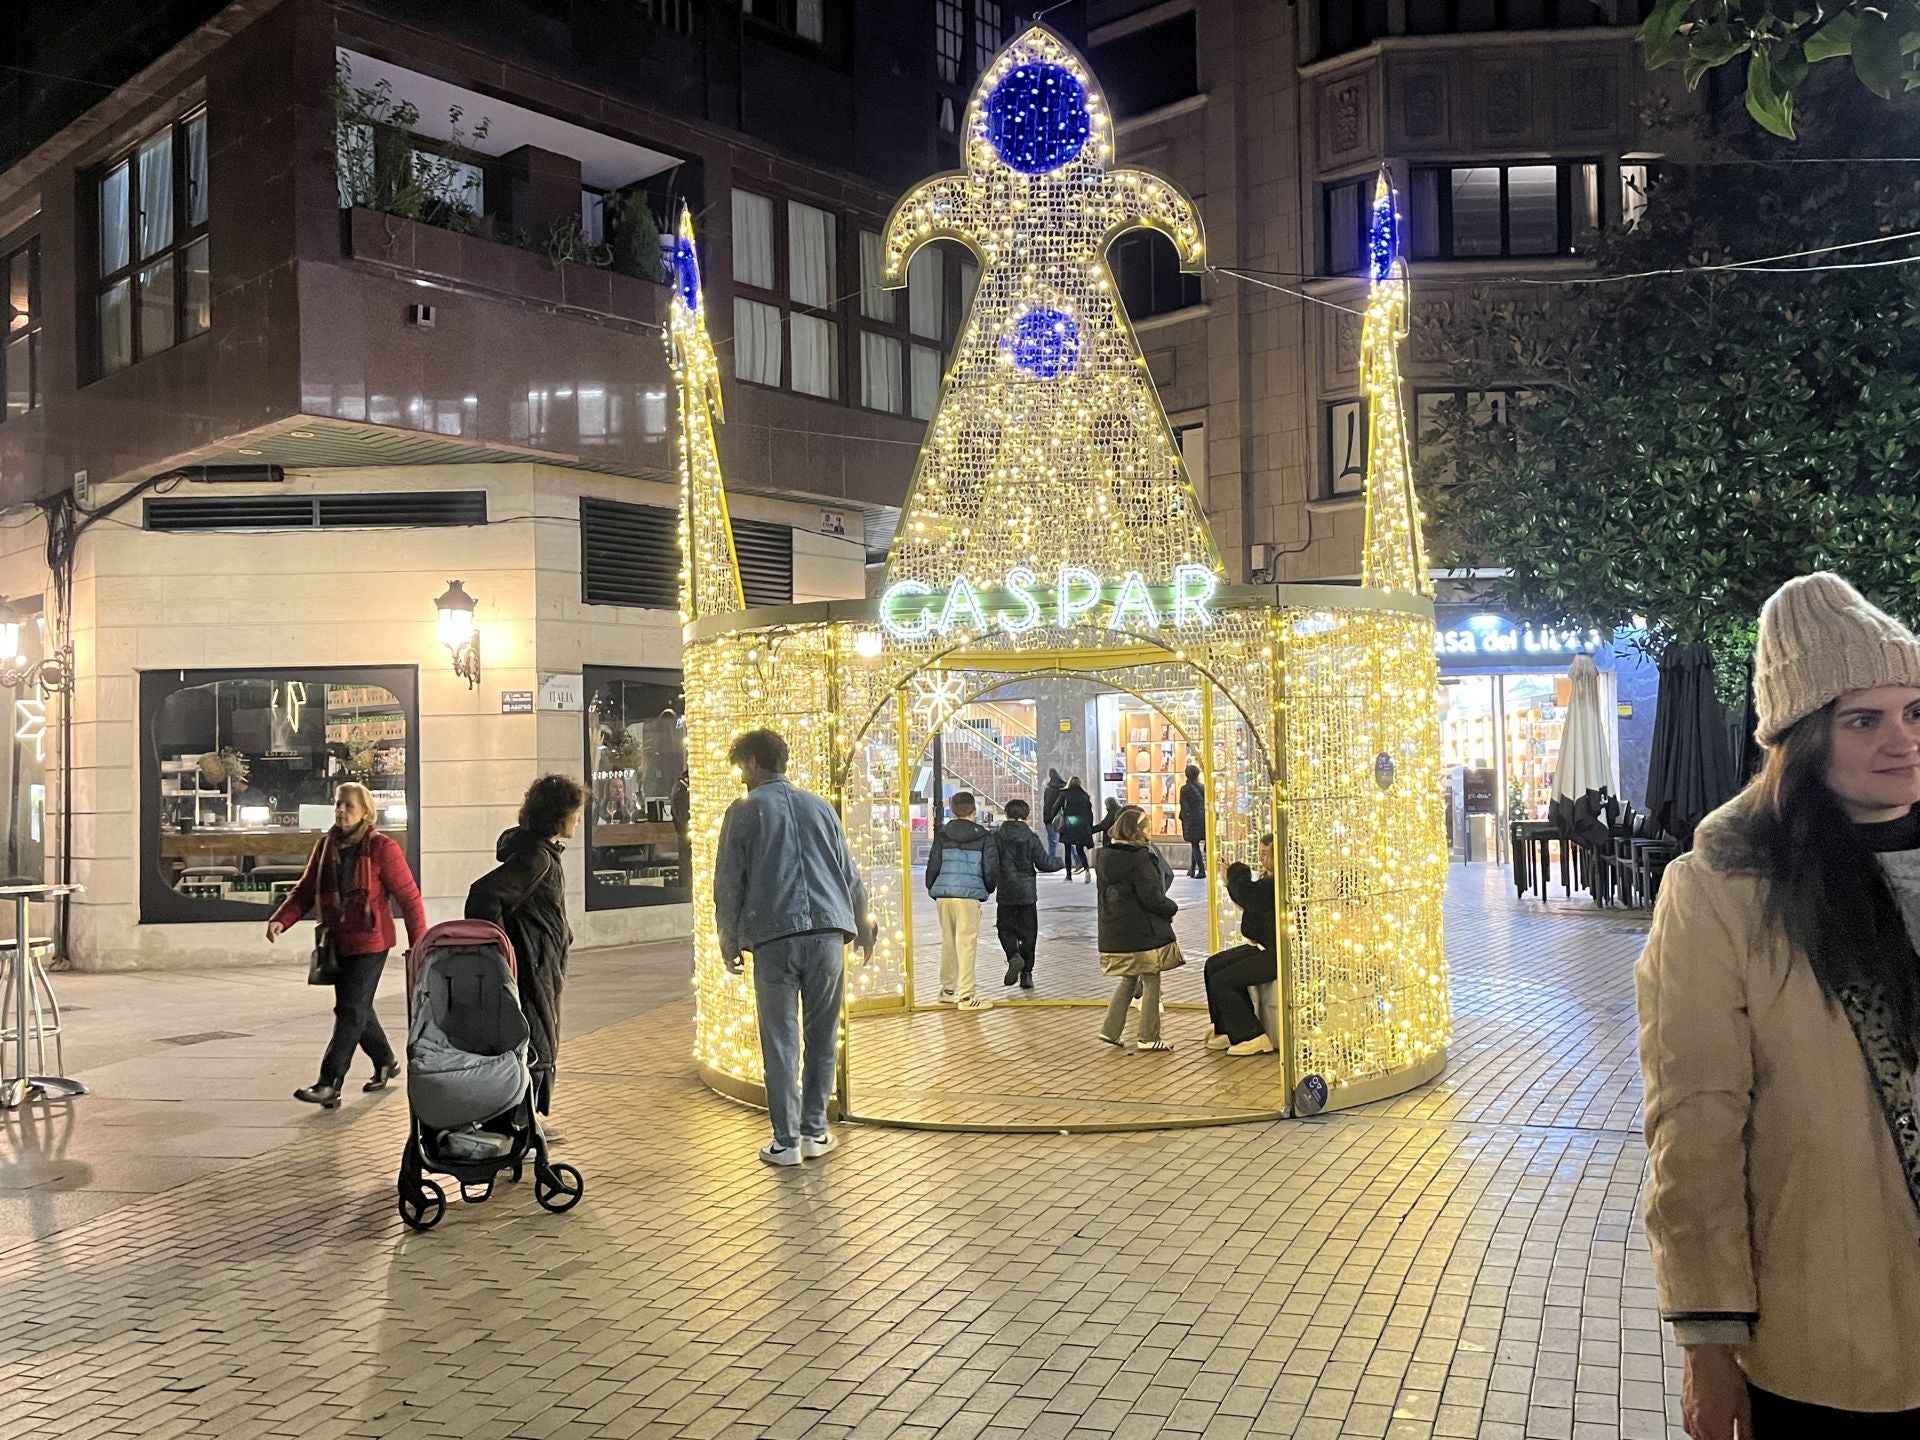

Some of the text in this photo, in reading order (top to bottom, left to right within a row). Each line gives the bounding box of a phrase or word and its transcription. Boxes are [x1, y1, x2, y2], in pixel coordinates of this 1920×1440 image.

[879, 563, 1217, 638] GASPAR
[1434, 629, 1476, 653] asa
[1481, 628, 1518, 652] del
[549, 691, 574, 703] ITALIA
[273, 814, 298, 825] IJÓN
